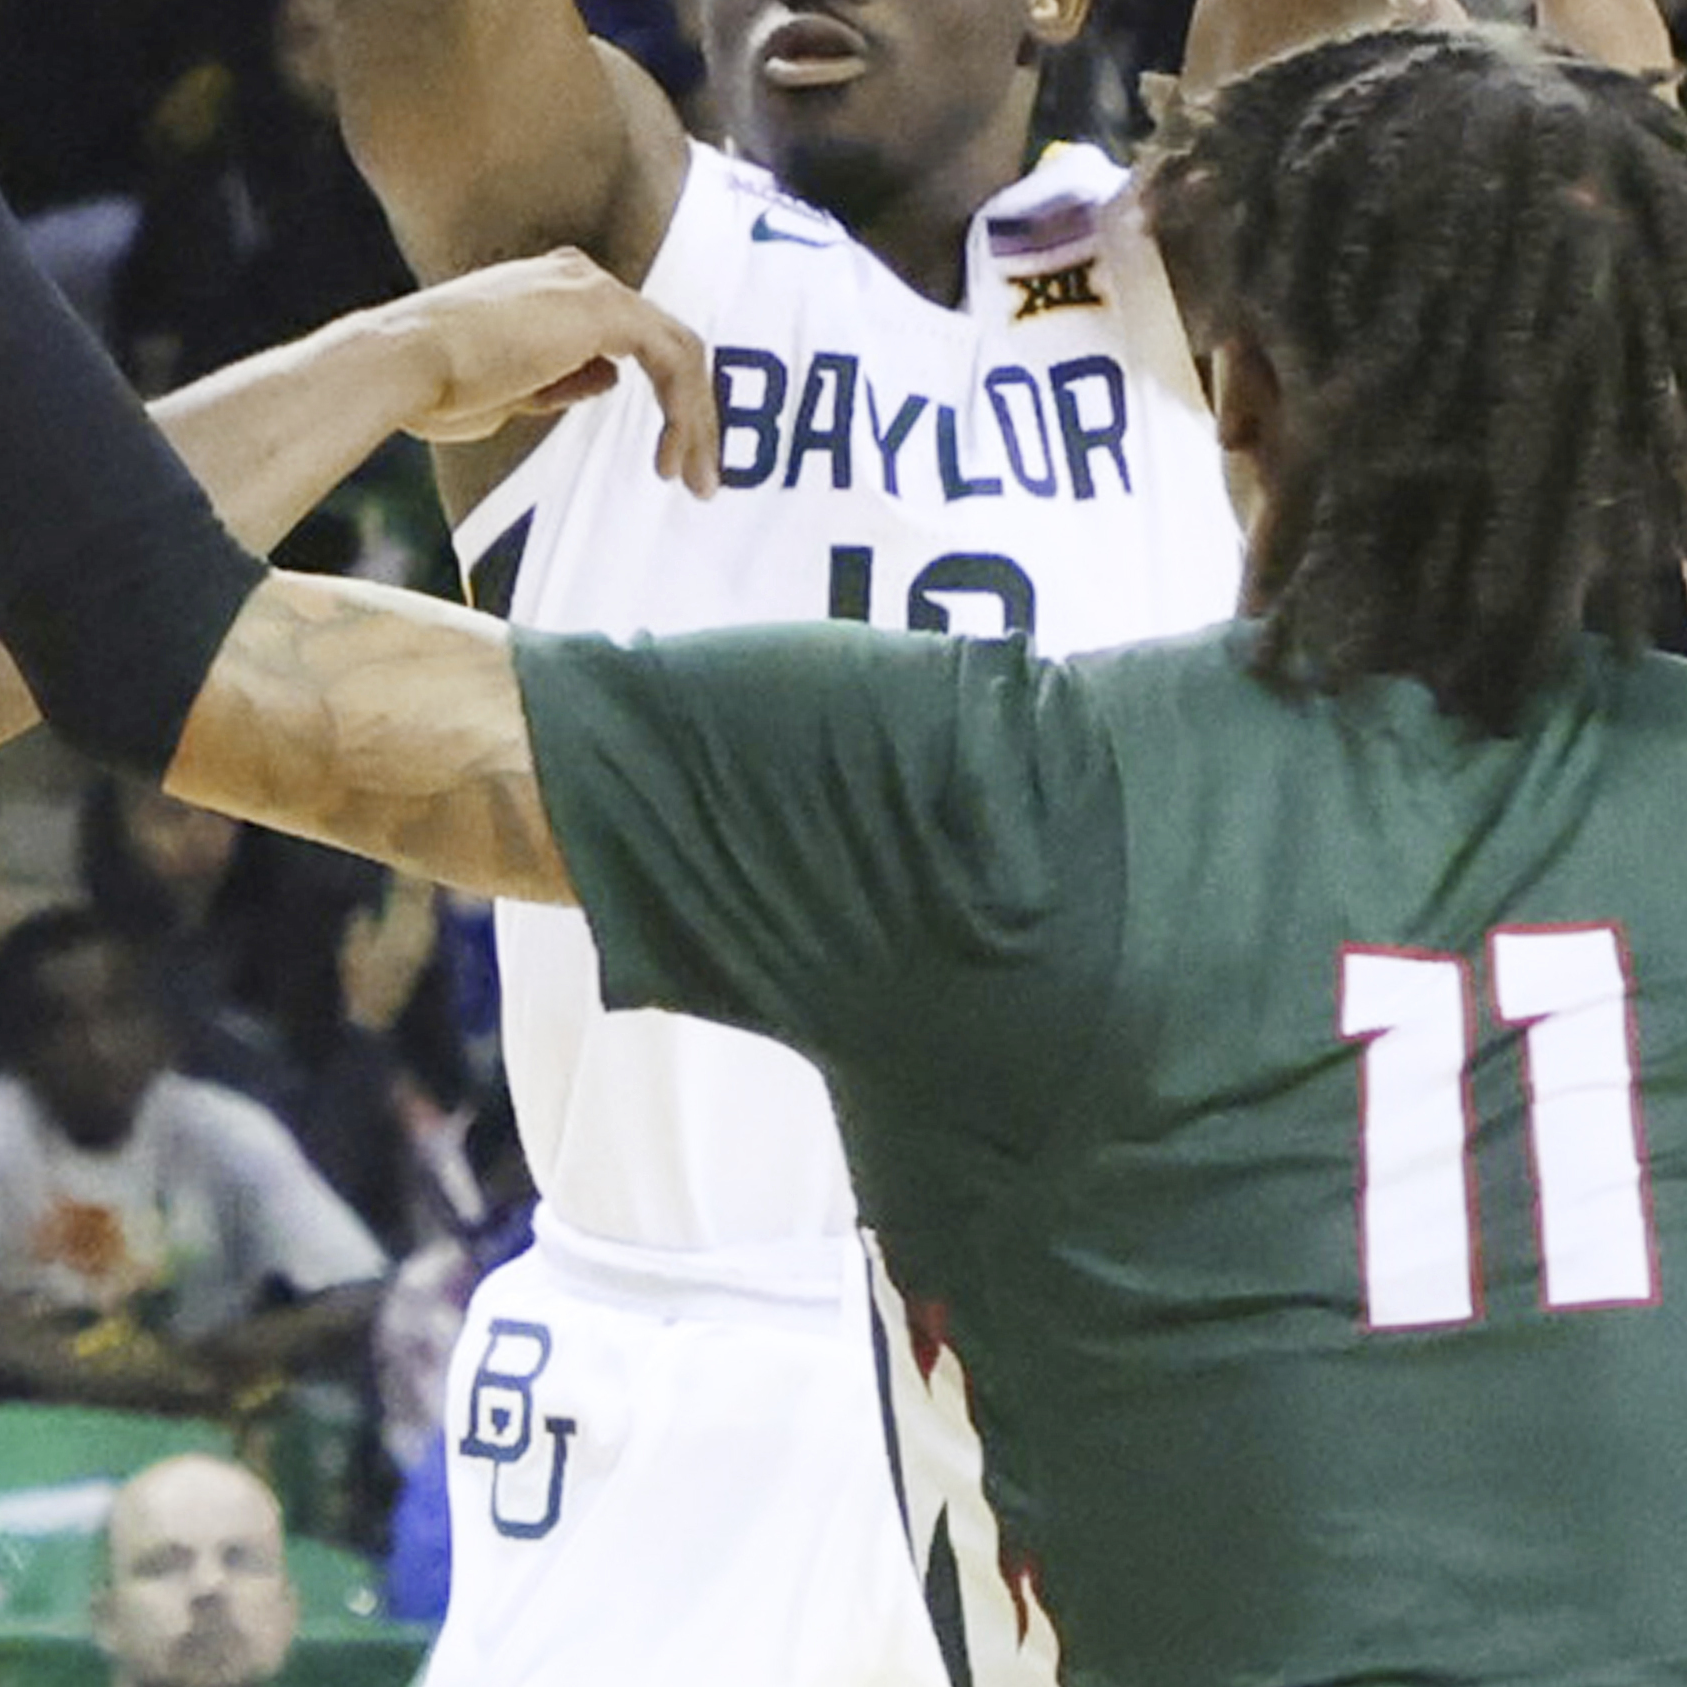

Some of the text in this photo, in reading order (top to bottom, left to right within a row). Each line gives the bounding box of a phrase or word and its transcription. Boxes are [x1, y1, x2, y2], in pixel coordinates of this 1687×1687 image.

[713, 346, 1133, 502] BAYLOR
[1337, 922, 1663, 1334] 11
[459, 1317, 578, 1540] BU
